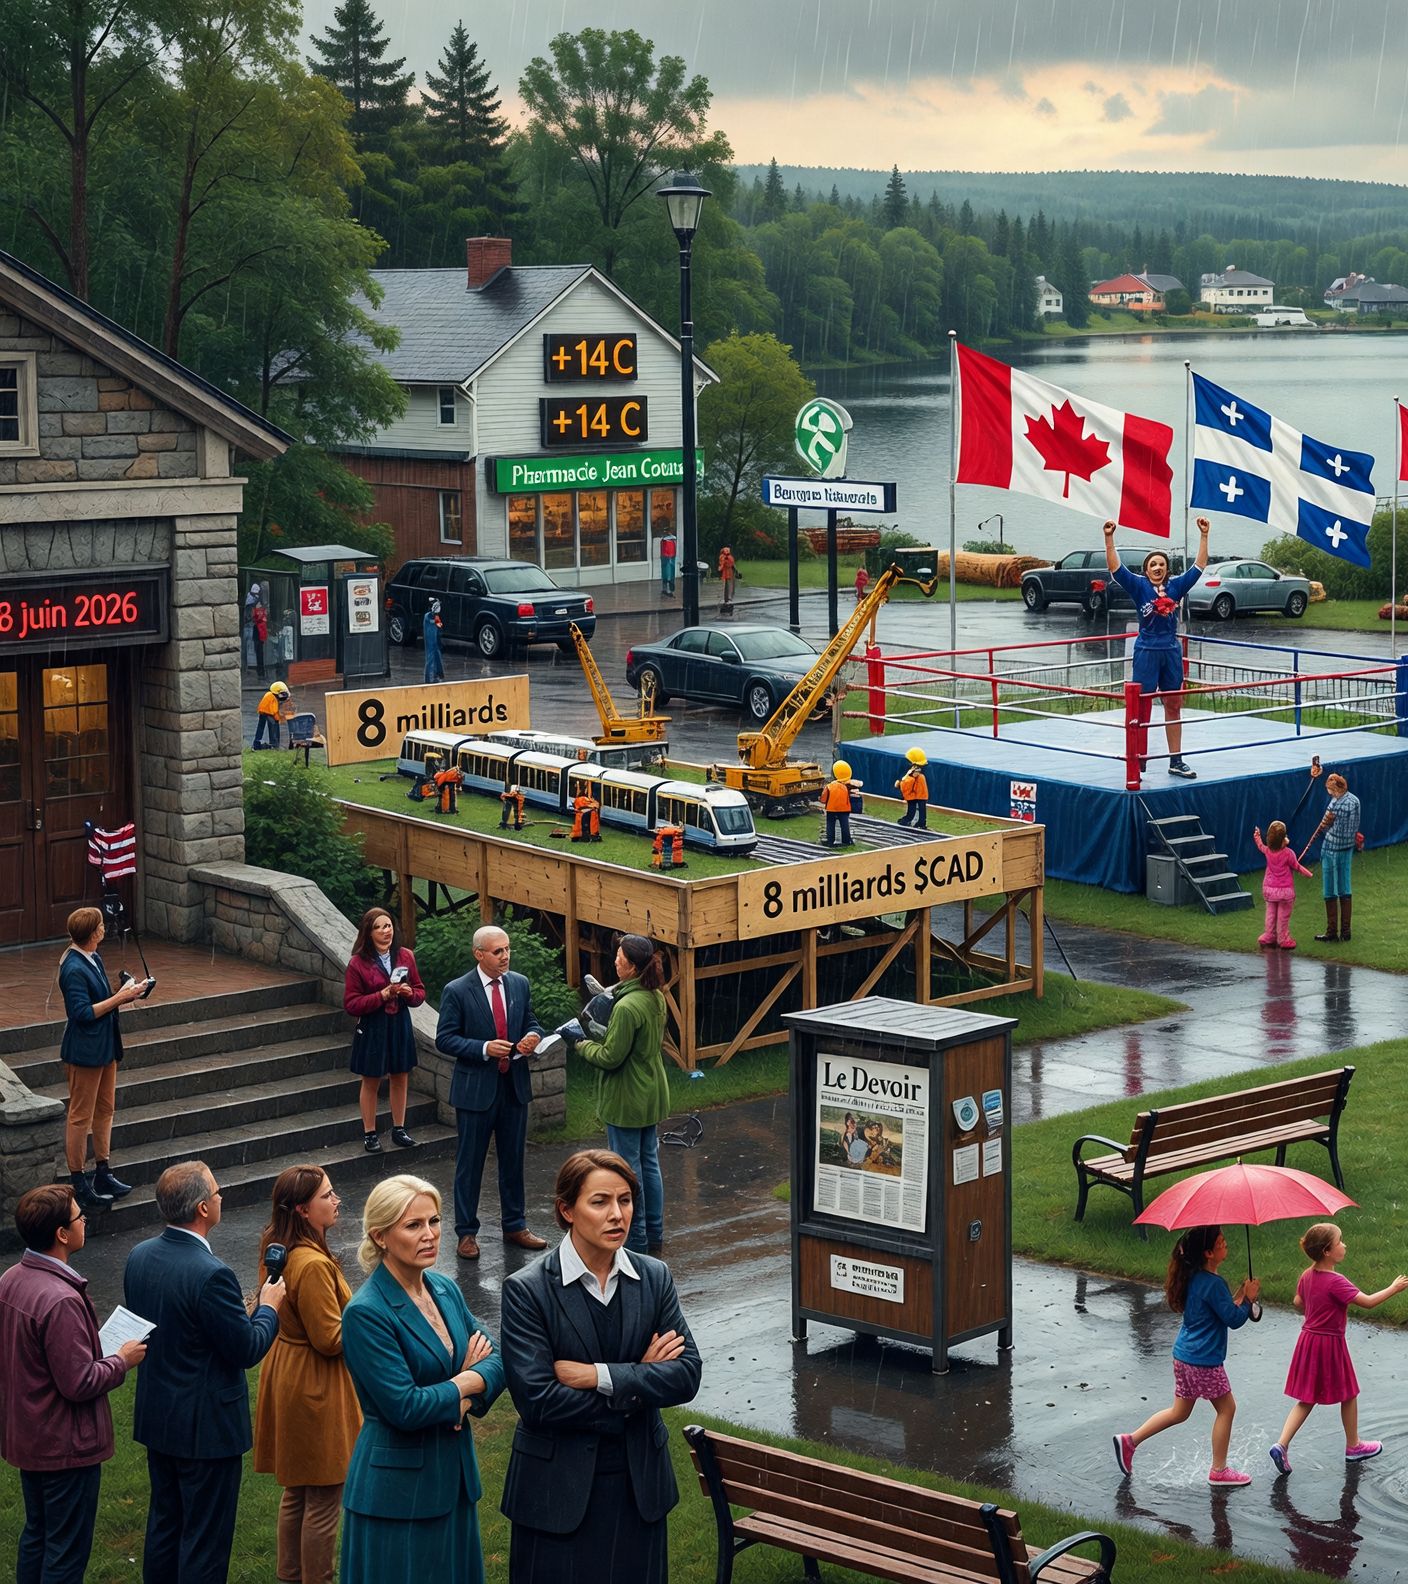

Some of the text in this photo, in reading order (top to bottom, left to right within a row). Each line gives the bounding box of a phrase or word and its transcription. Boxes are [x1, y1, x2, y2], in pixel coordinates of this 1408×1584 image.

[552, 339, 634, 375] +14C
[553, 401, 641, 438] +14 C
[602, 460, 637, 482] Jean
[18, 599, 67, 639] juin
[74, 592, 138, 627] 2026
[356, 694, 508, 748] 8 milliards
[763, 851, 984, 919] 8 milliards $CAD
[823, 1062, 922, 1102] Le Devoir
